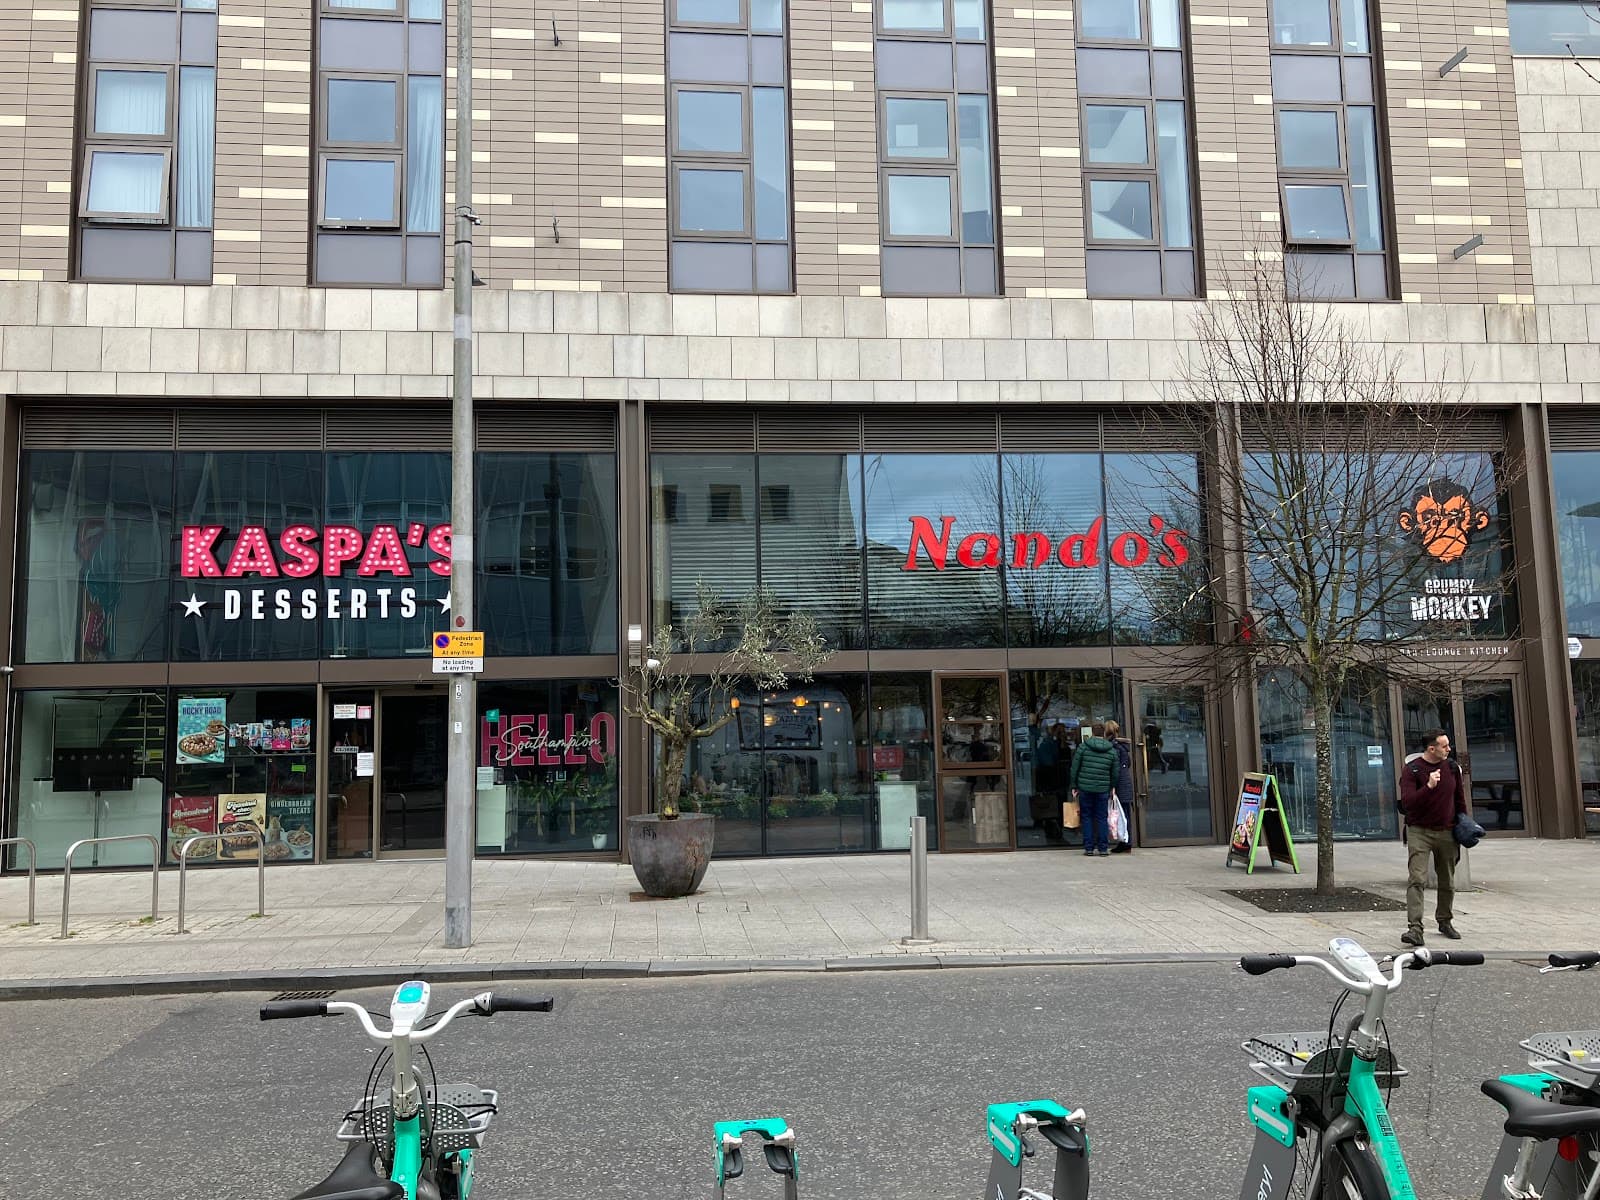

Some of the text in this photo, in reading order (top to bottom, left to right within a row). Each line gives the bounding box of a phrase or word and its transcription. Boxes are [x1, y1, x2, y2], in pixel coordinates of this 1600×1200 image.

[181, 521, 452, 578] KASPA'S
[901, 514, 1190, 572] Nando's
[1425, 578, 1475, 594] GRUMPY
[224, 587, 417, 620] DESSERTS
[1410, 595, 1492, 620] MONKEY
[1426, 647, 1462, 656] LOUNGE
[1469, 646, 1509, 656] KITCHEN
[182, 706, 222, 716] ROCKY ROAD
[481, 712, 616, 766] HELLO
[495, 724, 601, 761] Southampton
[289, 807, 311, 815] TREATS
